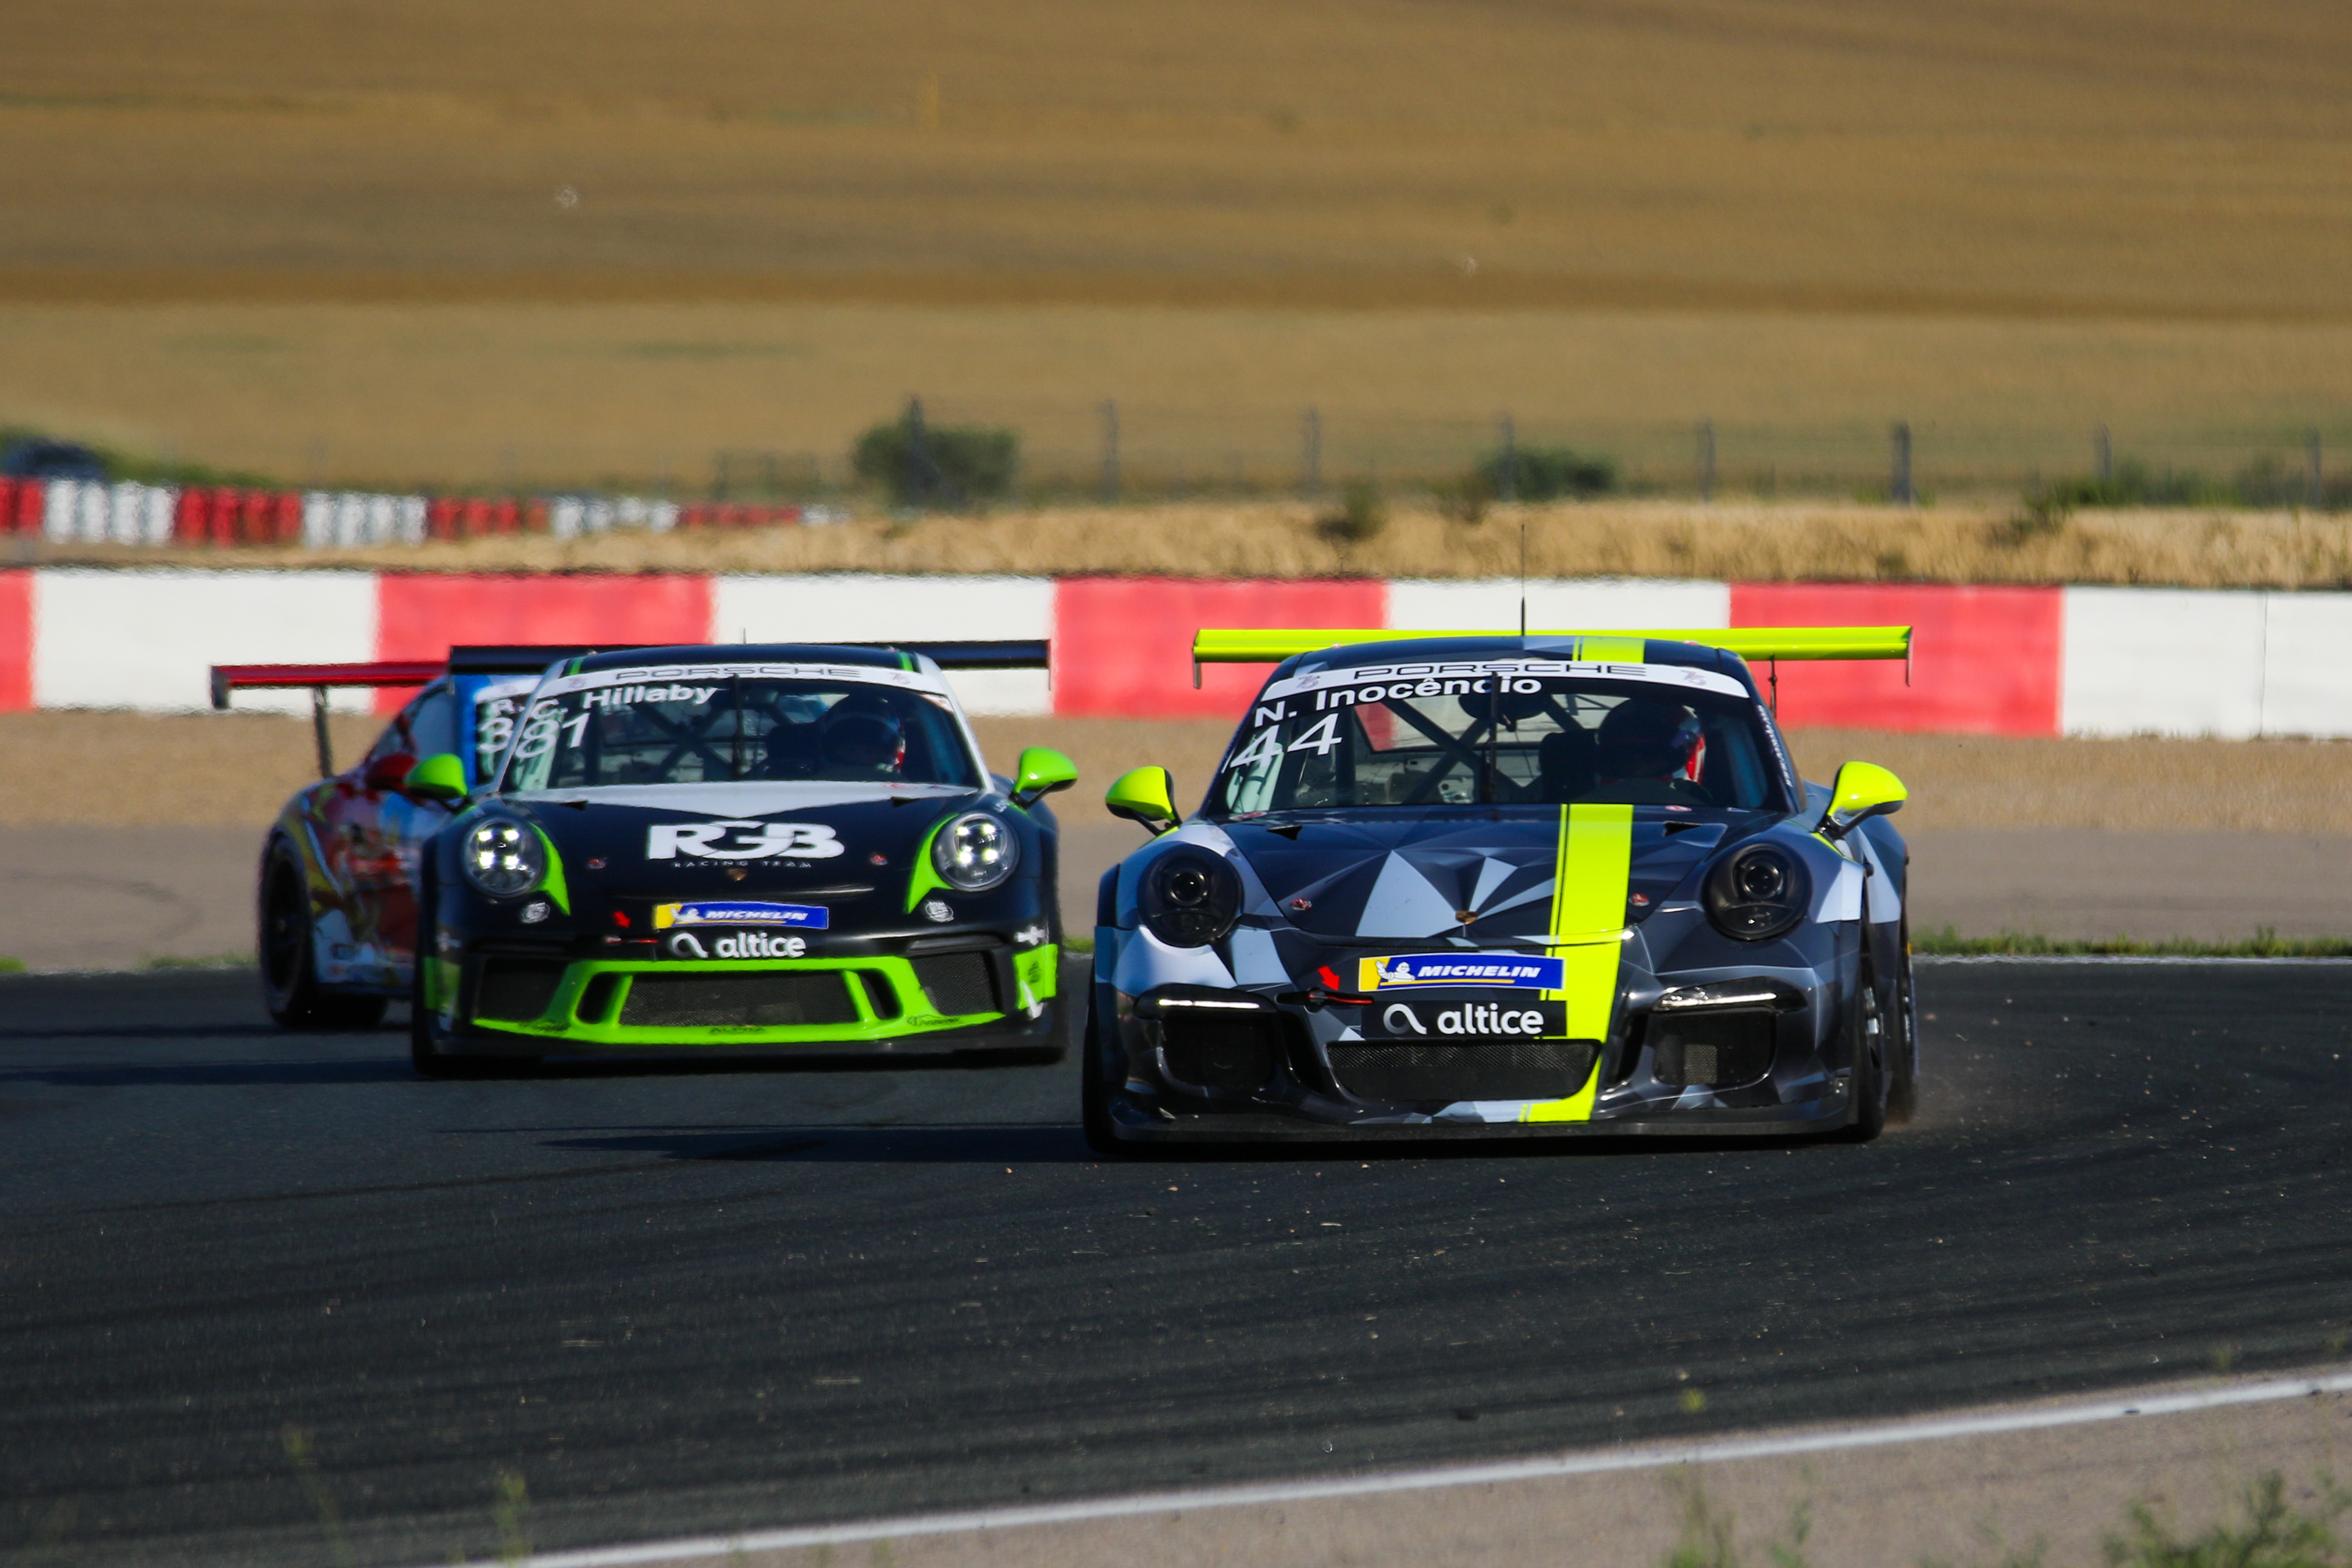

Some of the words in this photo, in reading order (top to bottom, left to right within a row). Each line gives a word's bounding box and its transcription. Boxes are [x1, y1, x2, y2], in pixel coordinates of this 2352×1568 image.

[616, 667, 861, 680] PORSCHE
[1354, 663, 1648, 679] PORSCHE
[583, 684, 718, 709] Hillaby
[1254, 701, 1297, 728] N.
[1316, 674, 1542, 711] Inocêncio
[515, 712, 591, 758] 81
[1230, 713, 1342, 768] 44
[649, 820, 845, 859] RGB
[706, 910, 809, 921] MICHELIN
[715, 930, 807, 958] altice
[1418, 965, 1542, 978] MICHELIN
[1438, 1003, 1544, 1035] altice
